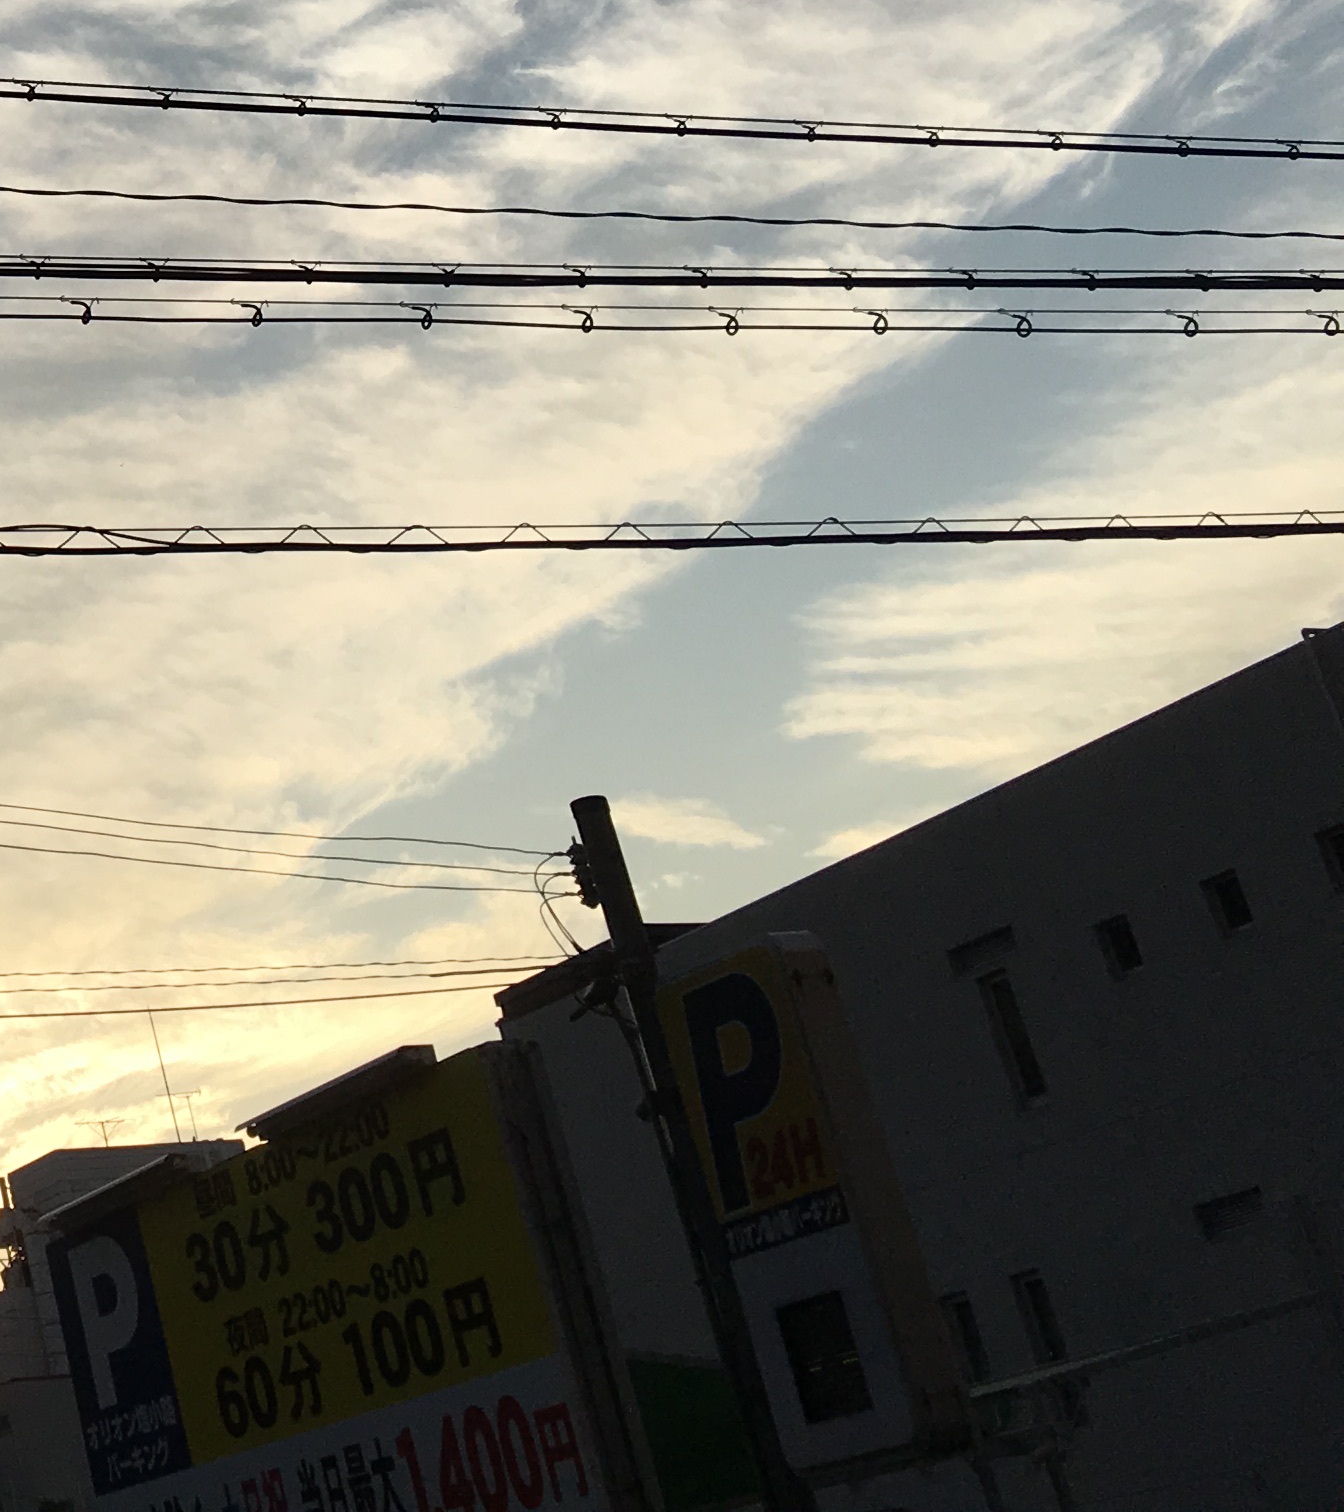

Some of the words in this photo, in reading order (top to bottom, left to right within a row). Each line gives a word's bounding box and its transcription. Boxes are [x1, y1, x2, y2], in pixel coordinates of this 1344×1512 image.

[682, 973, 781, 1212] P
[186, 1204, 291, 1302] 30分
[306, 1107, 467, 1254] 300円
[194, 1167, 237, 1218] 昼間
[745, 1116, 827, 1199] 24H
[67, 1235, 139, 1411] P
[216, 1341, 322, 1439] 60分
[342, 1276, 503, 1396] 100円
[224, 1307, 270, 1357] 夜間
[106, 1436, 170, 1482] パーキング
